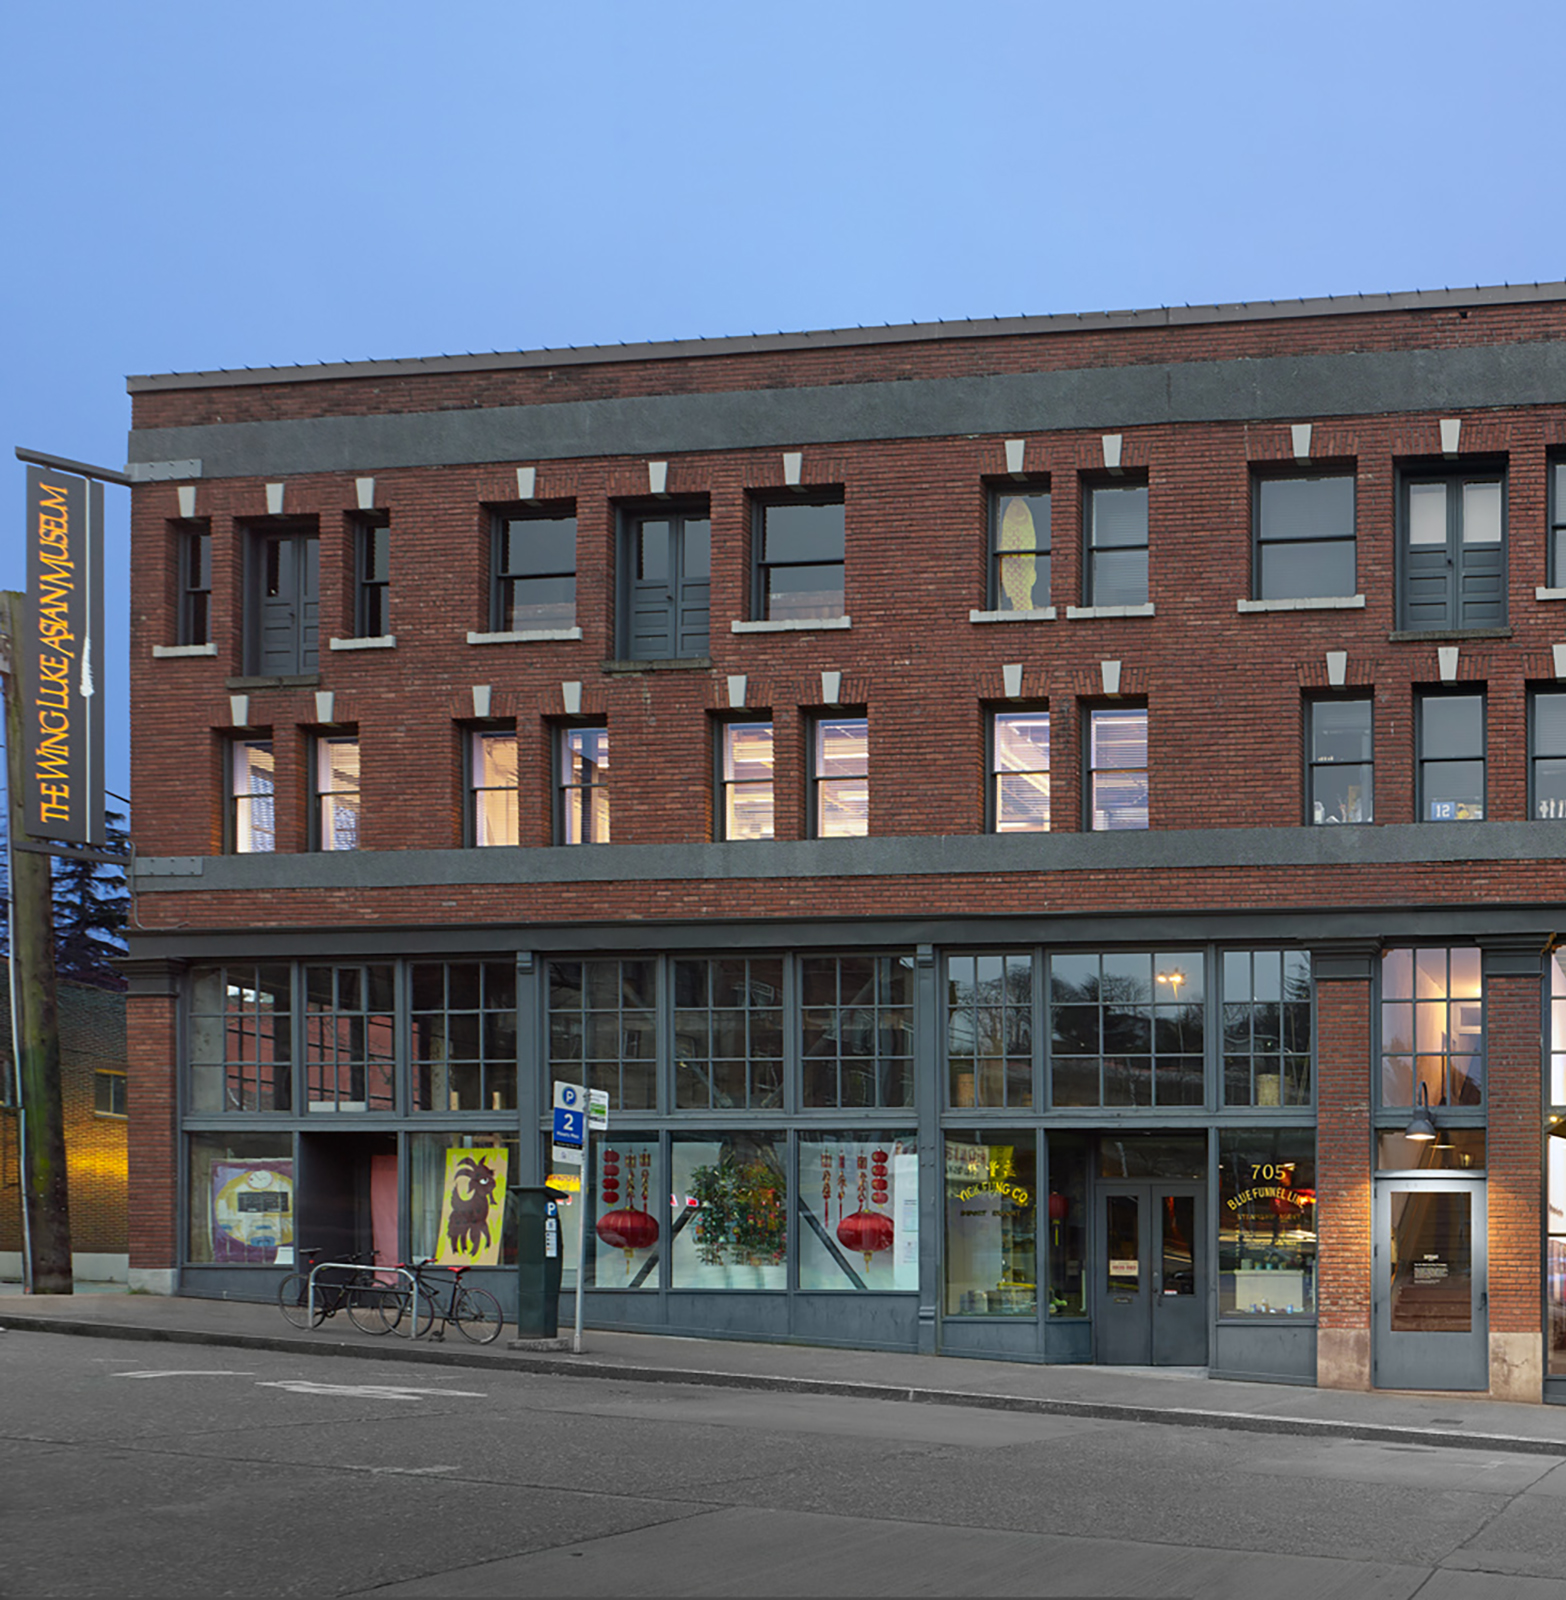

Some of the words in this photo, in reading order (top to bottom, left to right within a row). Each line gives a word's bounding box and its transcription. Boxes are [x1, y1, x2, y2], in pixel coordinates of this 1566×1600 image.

[39, 481, 75, 590] MUSEUM
[39, 583, 75, 659] ASIAN
[35, 654, 69, 709] LUKE
[35, 710, 70, 779] WING
[40, 782, 69, 823] THE
[1436, 804, 1450, 818] 12
[566, 1090, 575, 1102] P
[563, 1113, 574, 1131] 2
[1251, 1163, 1286, 1180] 705
[547, 1202, 556, 1216] P
[1226, 1189, 1253, 1211] BLUE
[1252, 1186, 1286, 1200] FUNNEL
